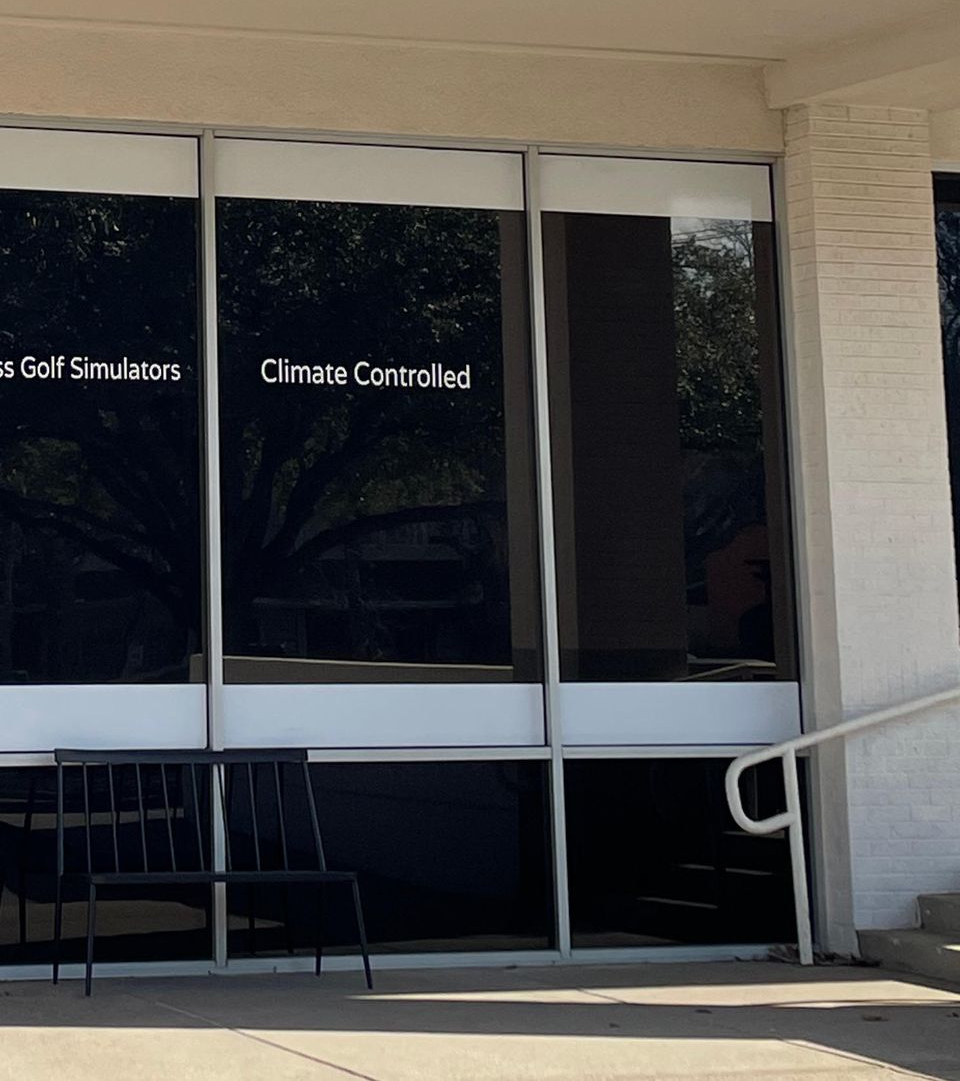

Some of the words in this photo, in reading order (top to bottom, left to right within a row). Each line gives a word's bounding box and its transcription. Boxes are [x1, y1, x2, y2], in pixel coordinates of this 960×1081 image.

[20, 355, 65, 379] Golf
[70, 356, 181, 381] Simulators
[261, 357, 348, 385] Climate
[354, 361, 471, 389] Controlled
